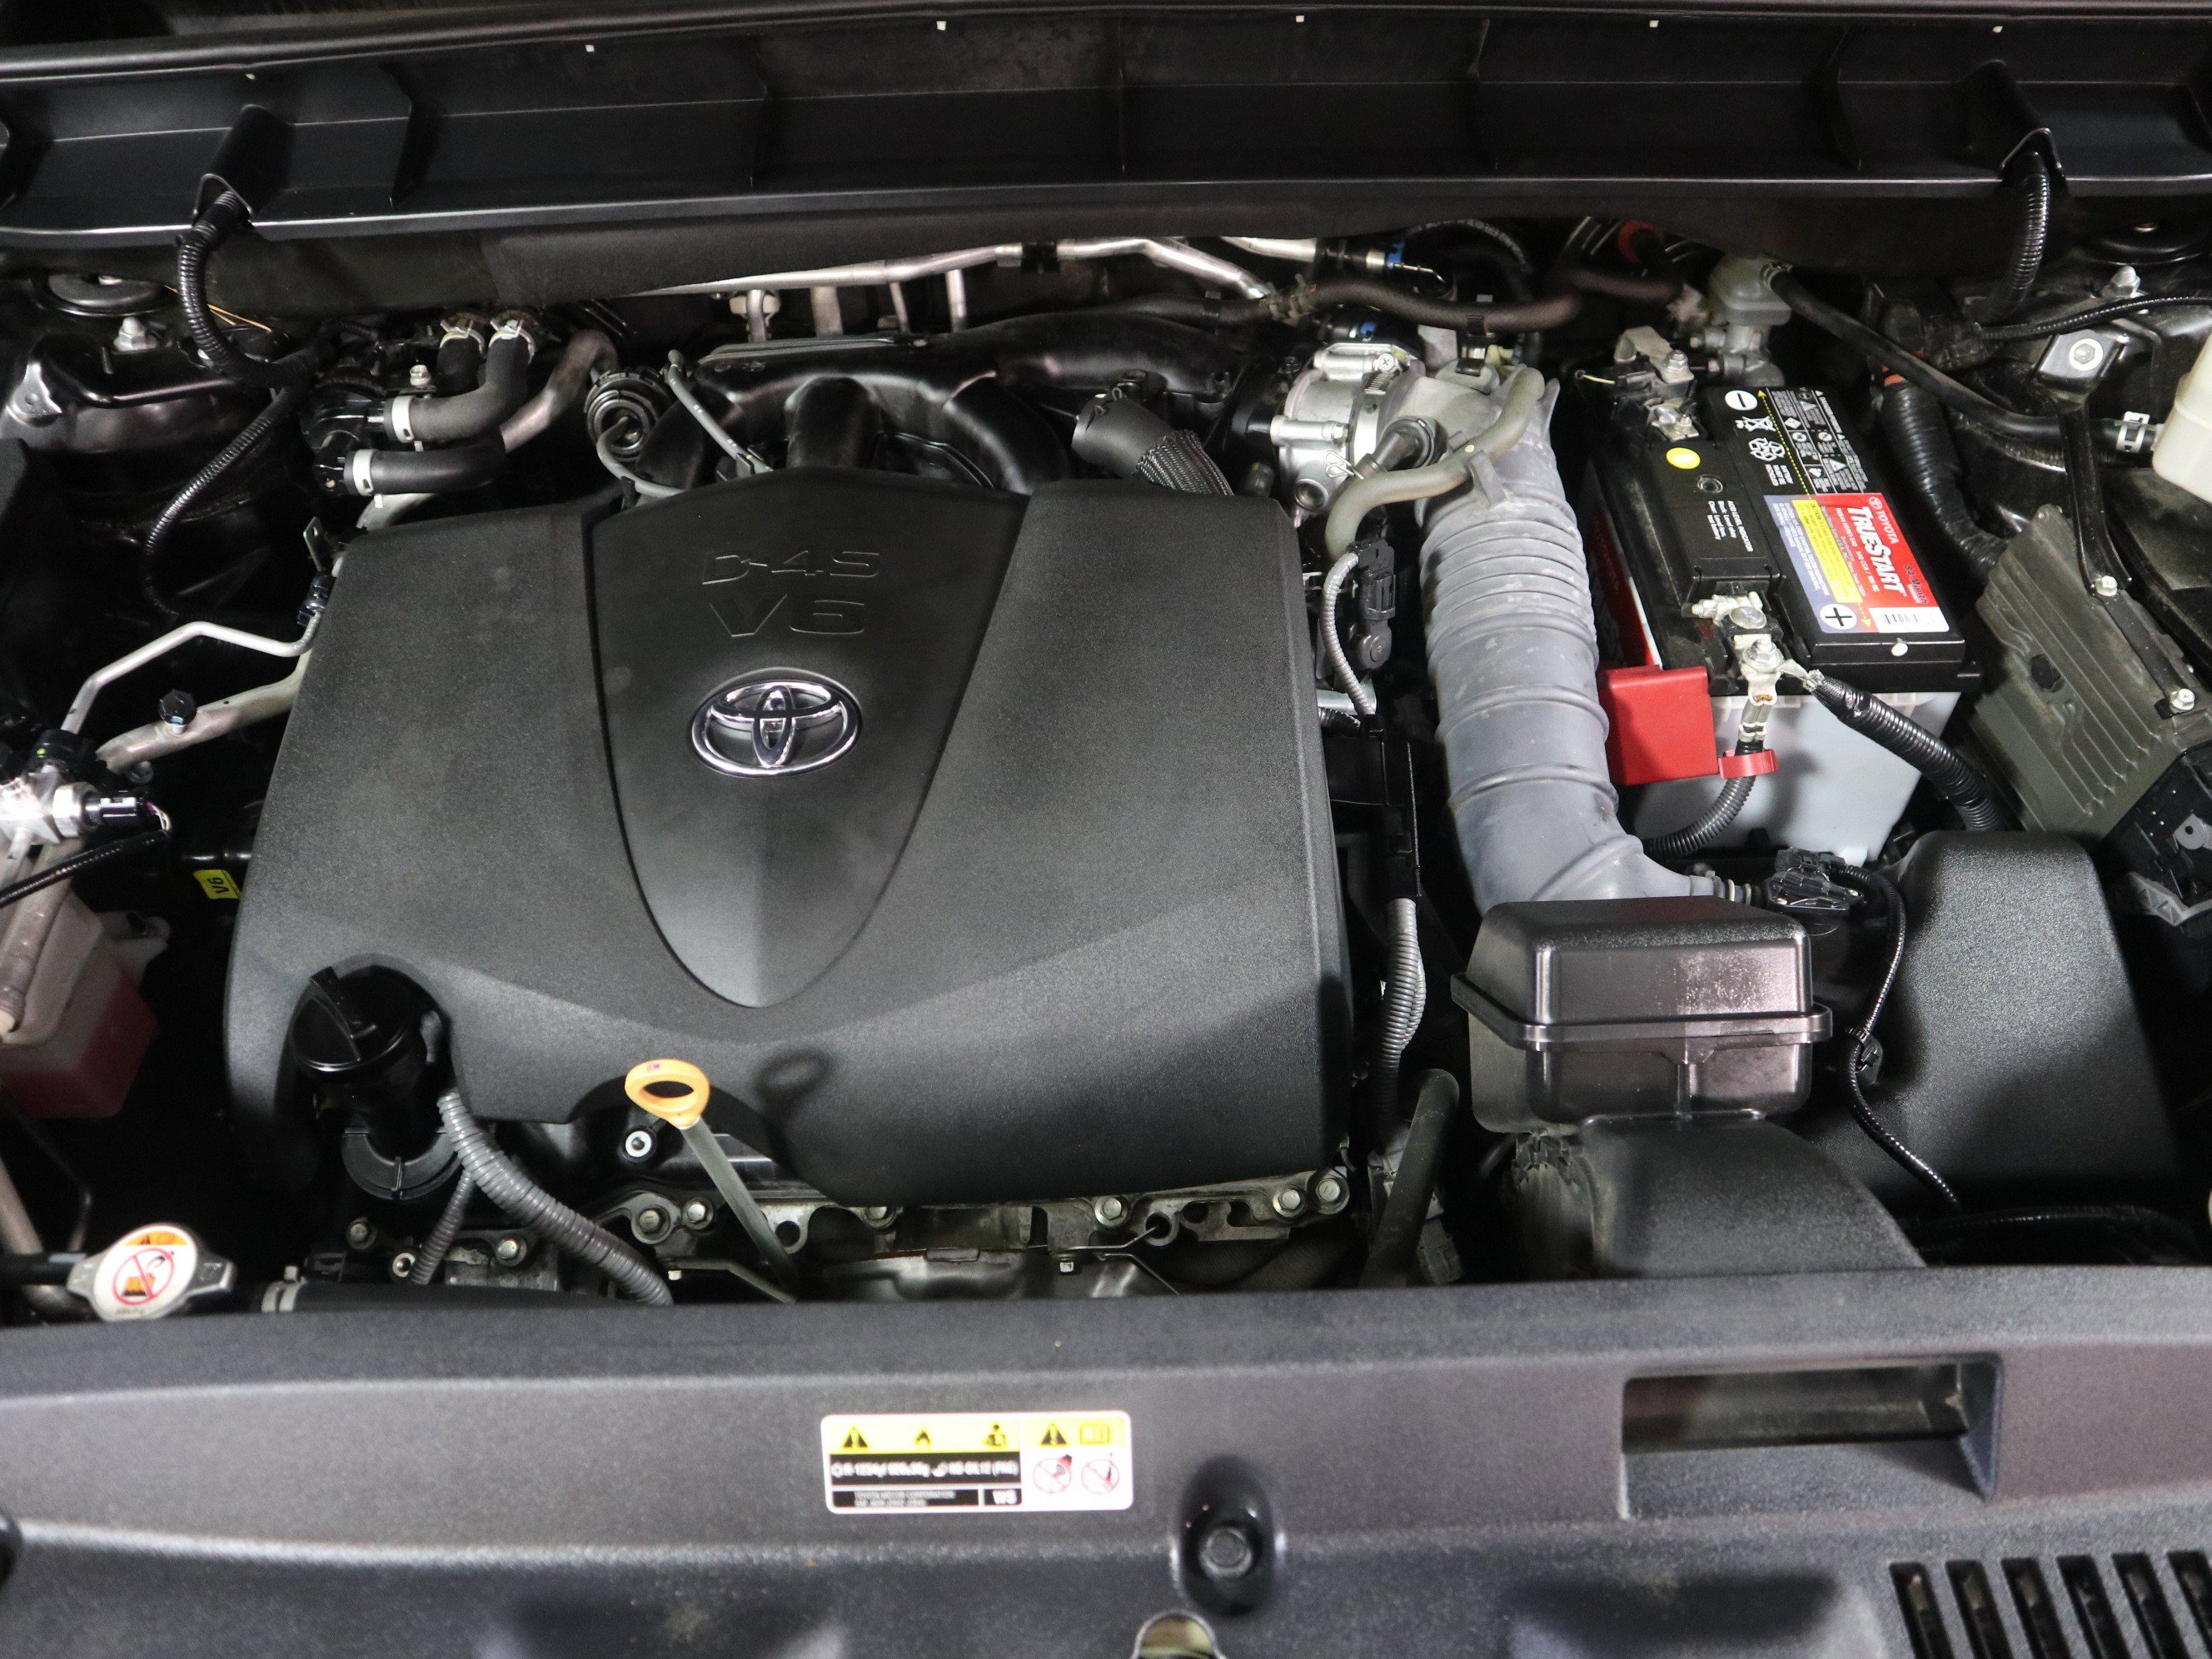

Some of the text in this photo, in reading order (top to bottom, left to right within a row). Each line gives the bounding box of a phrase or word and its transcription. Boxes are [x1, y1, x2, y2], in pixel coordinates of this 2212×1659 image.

[1876, 509, 1900, 544] TOYOTA
[1910, 576, 1929, 604] Month
[207, 877, 229, 894] V6
